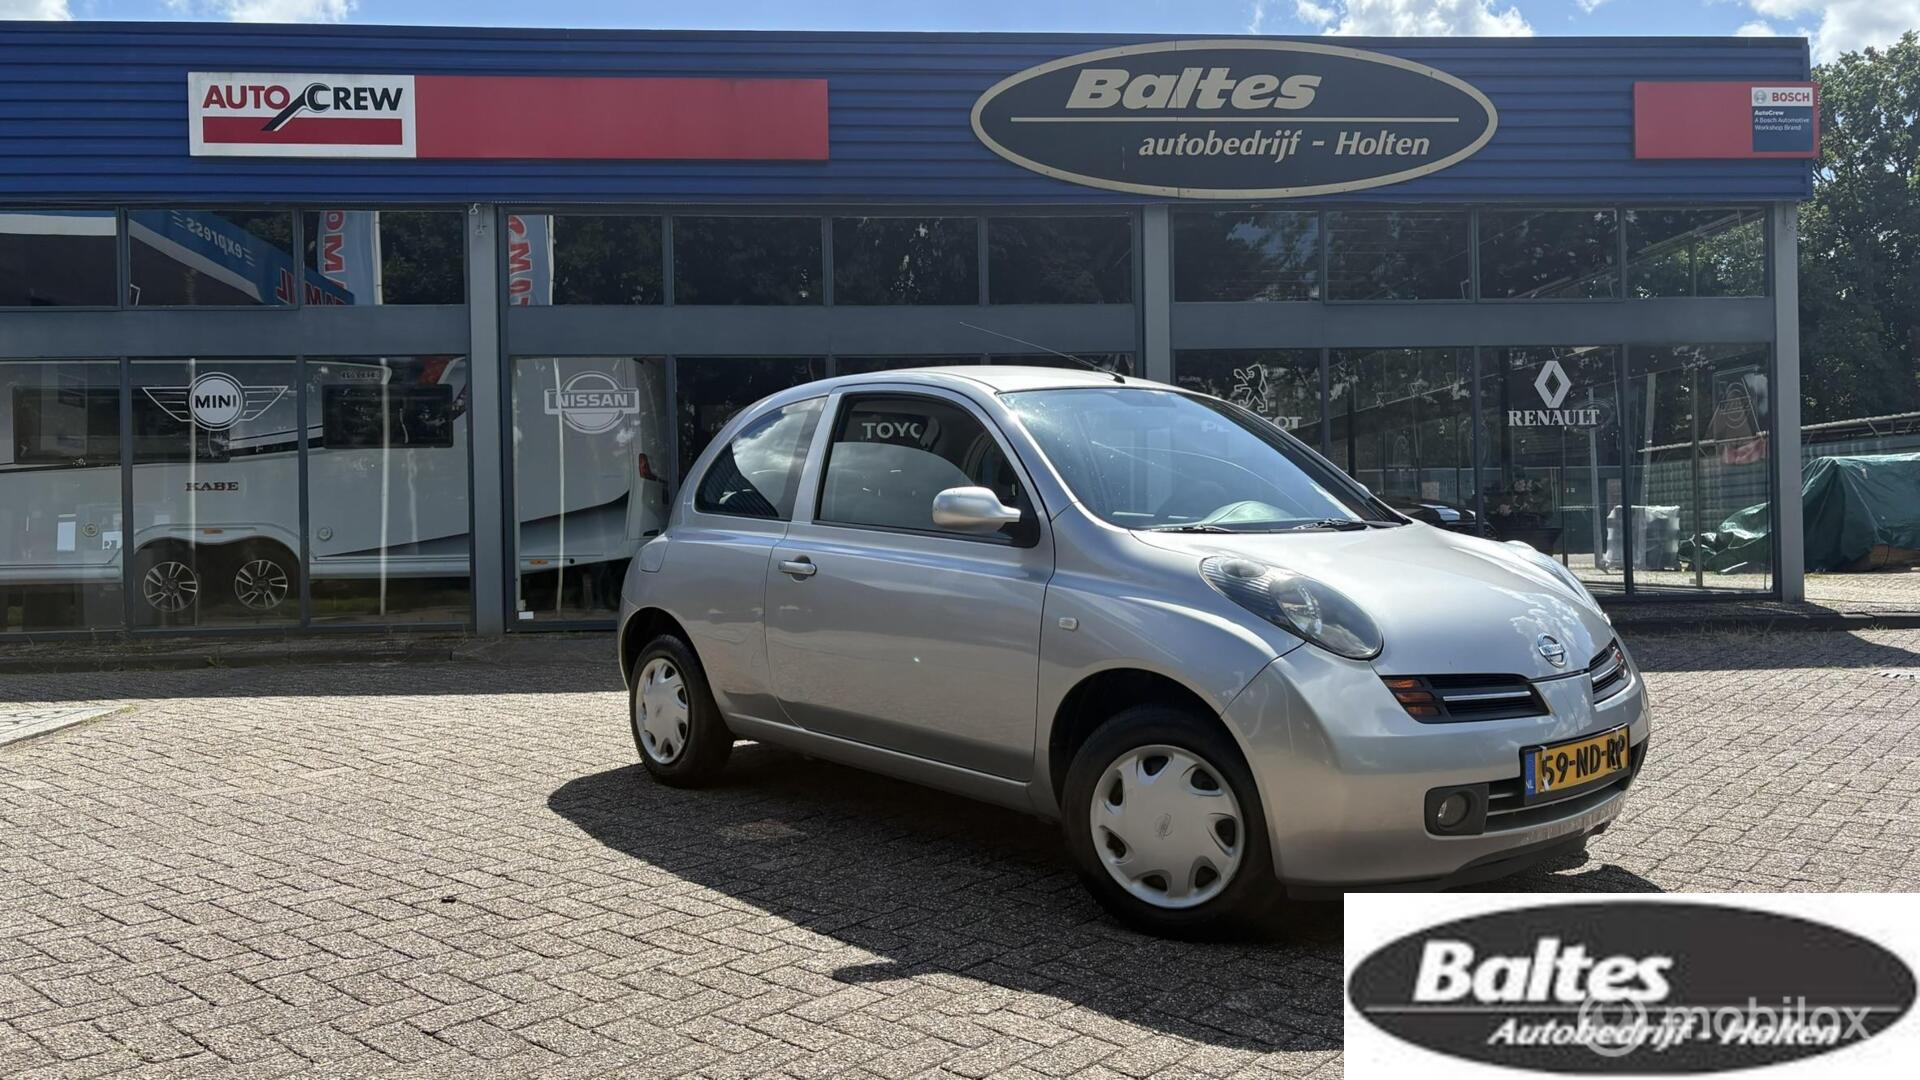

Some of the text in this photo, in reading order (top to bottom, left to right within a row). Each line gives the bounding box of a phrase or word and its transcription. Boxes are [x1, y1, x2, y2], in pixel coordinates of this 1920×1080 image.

[1065, 67, 1323, 110] Baltes
[202, 83, 404, 112] AUTO CREW
[1771, 92, 1810, 102] BOSCH
[1138, 130, 1302, 163] autobedrijf
[1334, 131, 1431, 157] Holten
[194, 394, 238, 409] MINI
[556, 393, 629, 408] NISSAN
[1507, 409, 1600, 426] RENAULT
[186, 482, 239, 492] KABE
